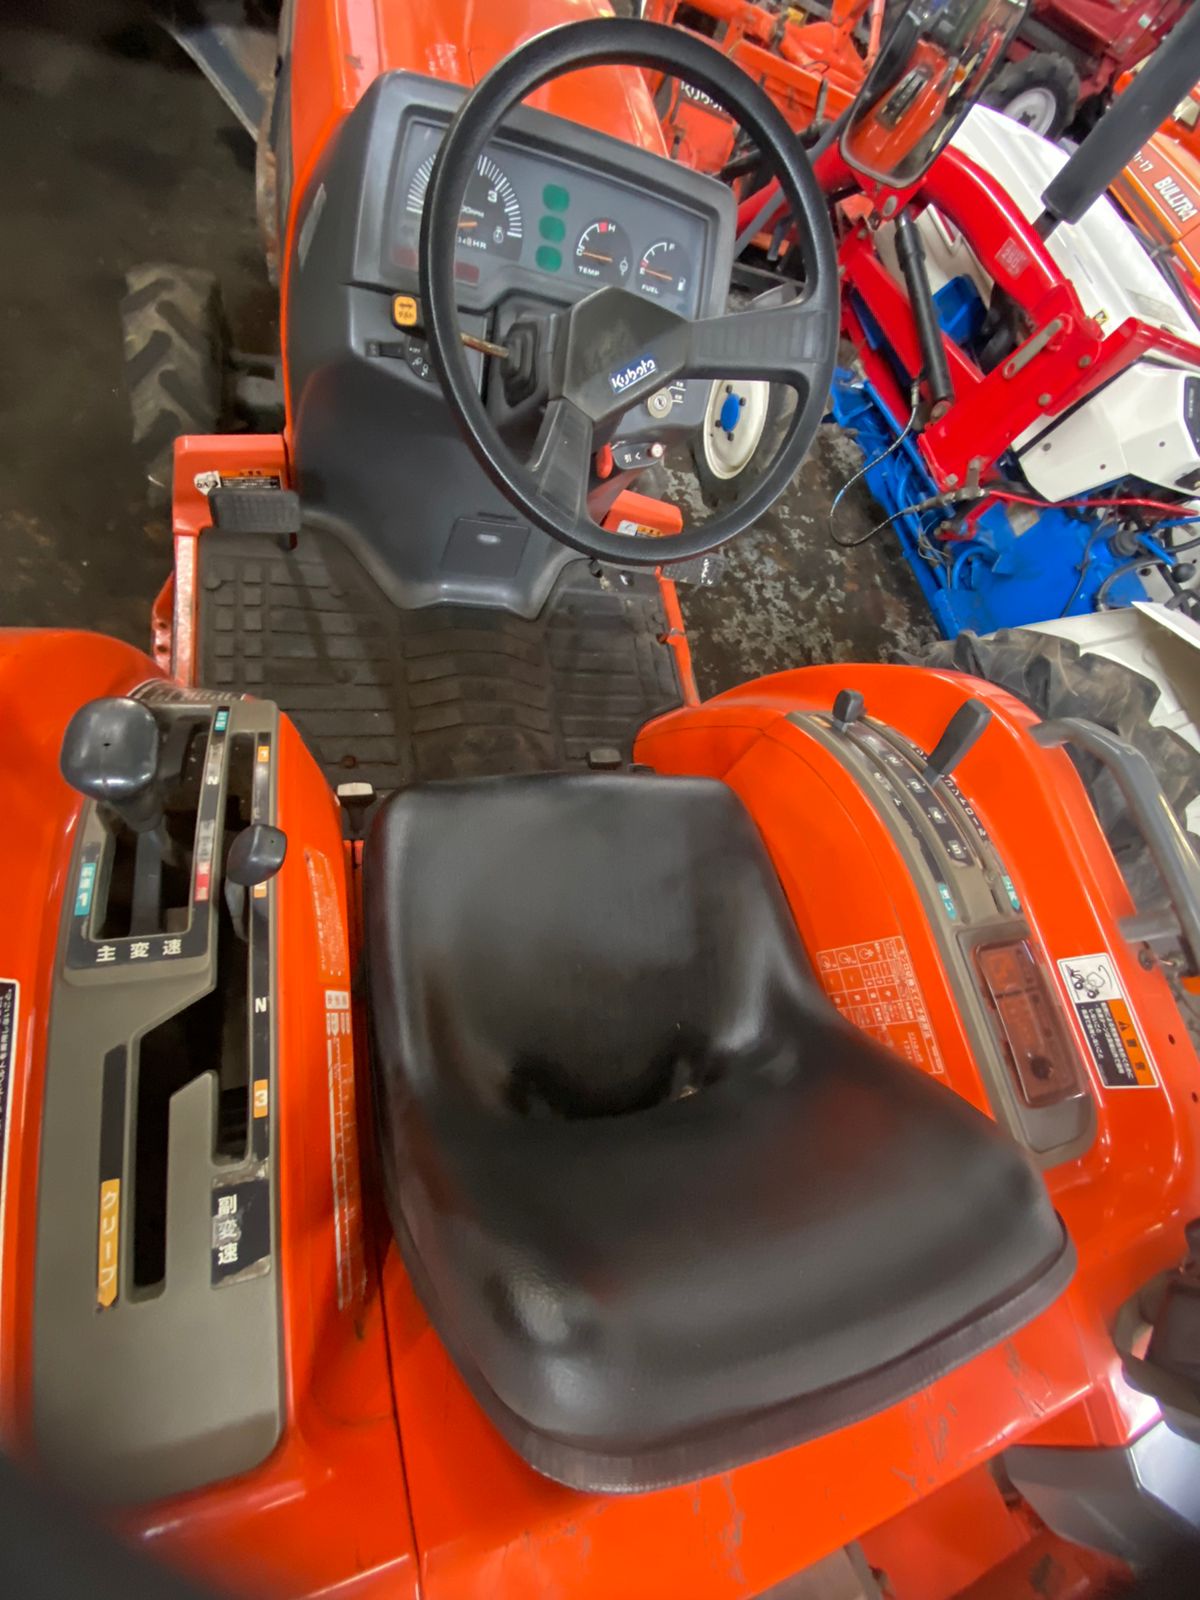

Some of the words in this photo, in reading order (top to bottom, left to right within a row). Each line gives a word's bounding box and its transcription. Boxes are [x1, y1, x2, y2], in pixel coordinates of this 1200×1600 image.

[487, 190, 498, 203] 3
[607, 223, 616, 232] H
[578, 266, 600, 276] TEMP
[641, 284, 660, 294] FUEL
[611, 359, 656, 389] Kubota
[96, 938, 182, 962] 主変速
[255, 997, 267, 1013] N
[255, 1089, 268, 1108] 3
[217, 1194, 239, 1265] 副変速
